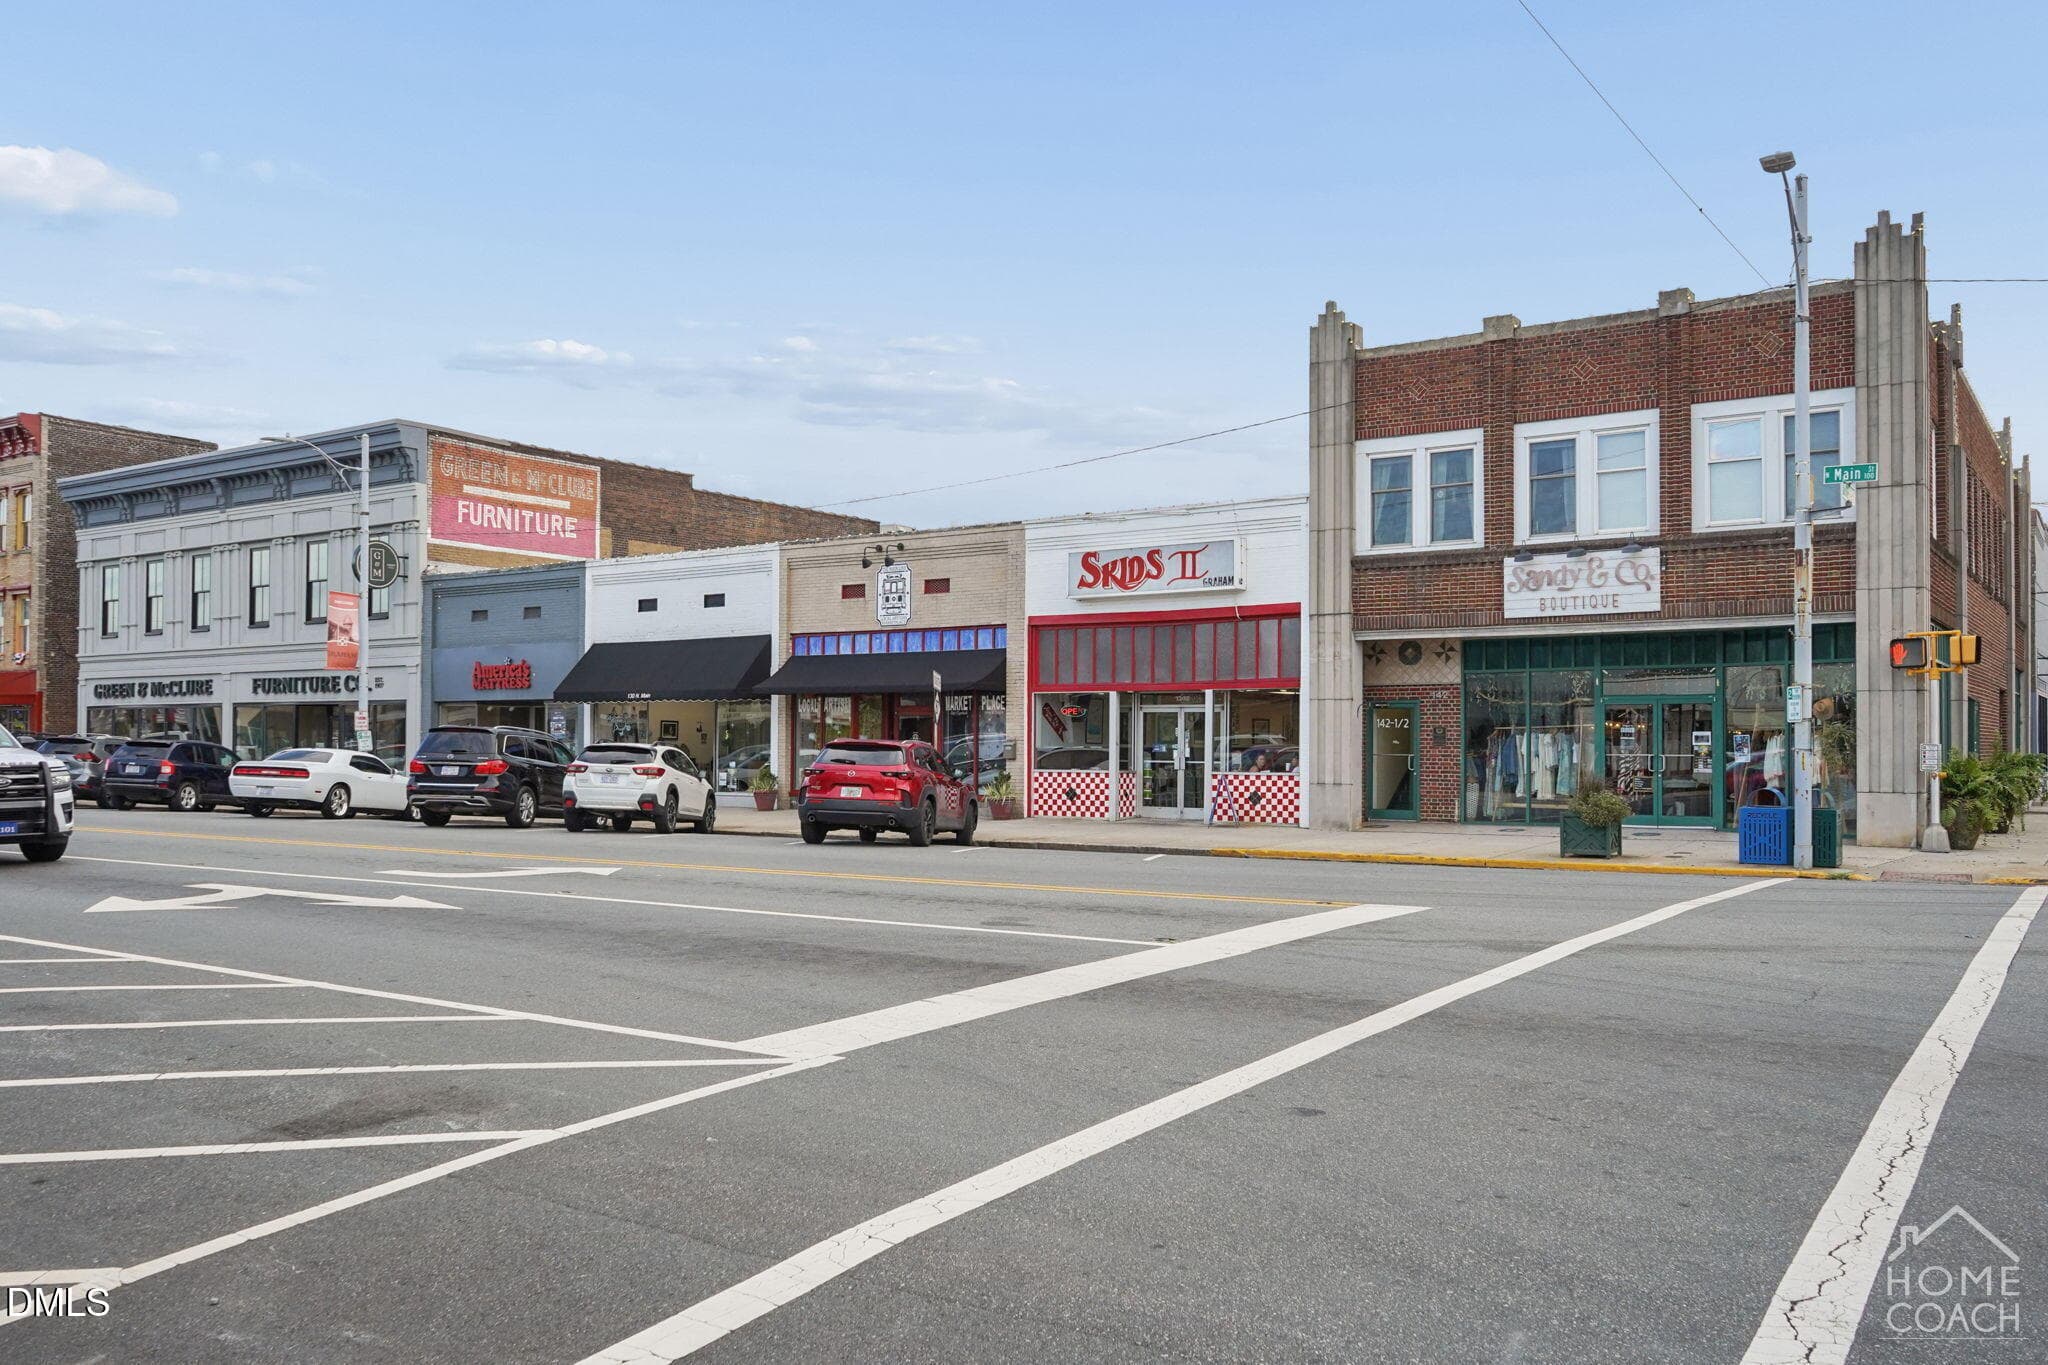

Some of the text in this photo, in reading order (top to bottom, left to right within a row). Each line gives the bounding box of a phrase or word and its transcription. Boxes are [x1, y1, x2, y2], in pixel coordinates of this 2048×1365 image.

[440, 455, 508, 486] GREEN
[511, 471, 522, 487] &
[1834, 468, 1861, 481] Main
[457, 500, 578, 538] FURNITURE
[373, 552, 381, 560] G
[1167, 544, 1209, 587] II
[1203, 575, 1234, 587] GRAHAM
[1507, 565, 1582, 593] Sandy
[1587, 556, 1609, 588] &
[1539, 594, 1619, 611] BOUTIQUE
[473, 659, 531, 679] America's
[94, 680, 213, 699] GREEN & McCLURE
[252, 676, 341, 695] FURNITURE
[472, 678, 531, 690] MATTRESS
[945, 695, 1005, 711] MARKET PLACE
[1432, 691, 1449, 699] 142
[798, 698, 818, 712] LOCAL
[1376, 718, 1410, 728] 142-1/2
